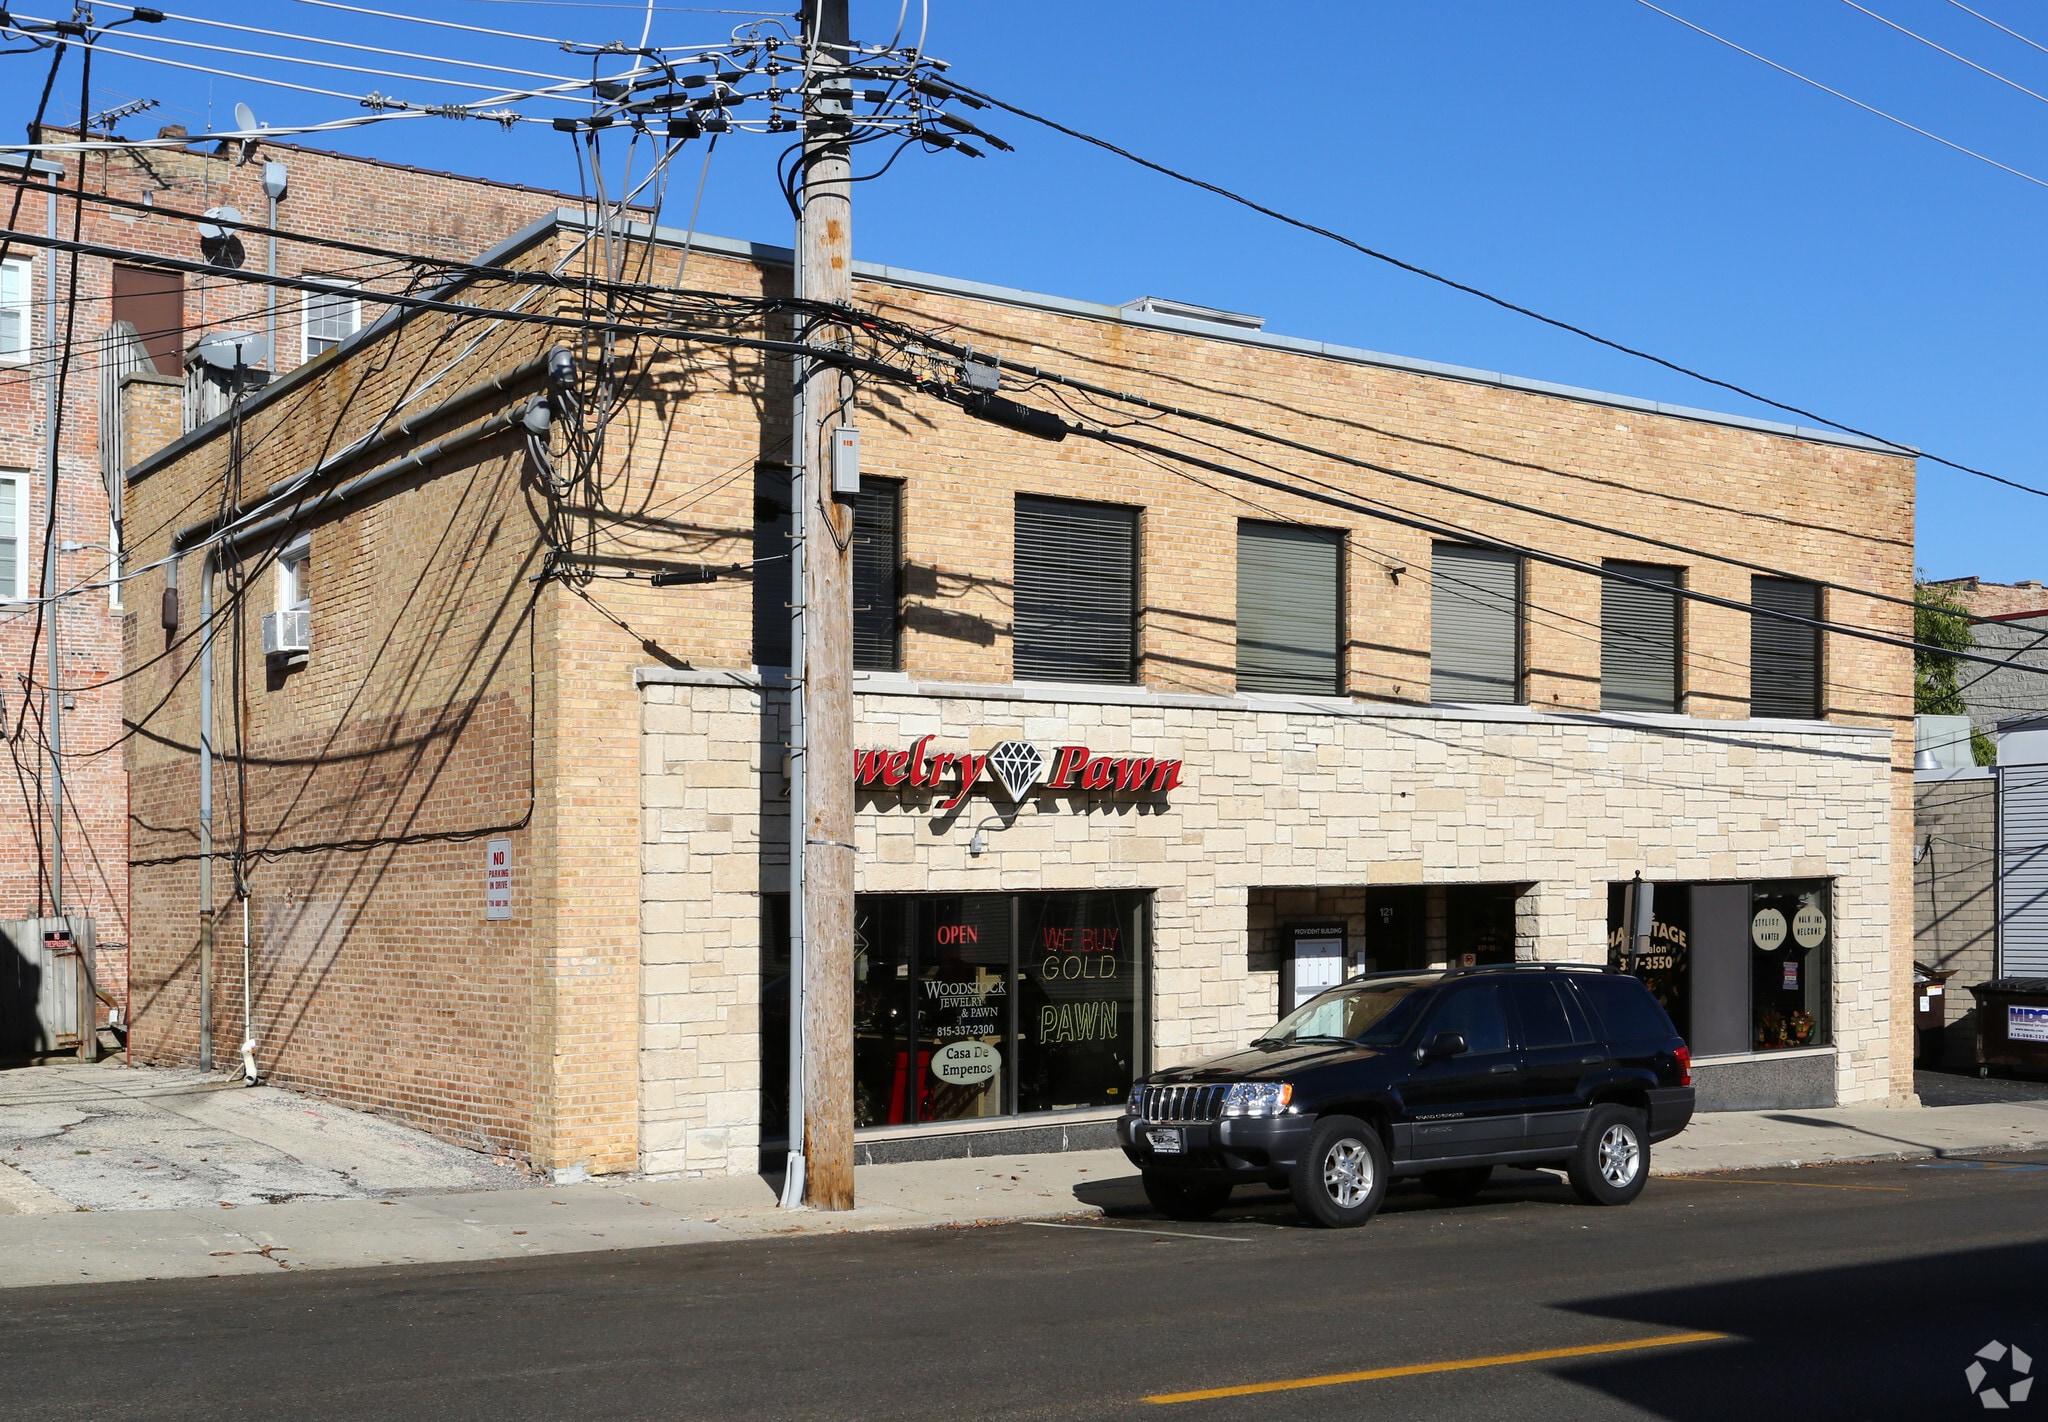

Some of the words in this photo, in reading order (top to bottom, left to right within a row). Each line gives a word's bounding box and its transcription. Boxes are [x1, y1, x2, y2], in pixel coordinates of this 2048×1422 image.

[854, 734, 986, 810] welry
[1048, 745, 1184, 793] Pawn
[493, 851, 504, 866] NO
[488, 869, 509, 878] PARKING
[489, 881, 494, 890] IN
[495, 880, 508, 889] DRIVE
[1379, 907, 1393, 917] 121
[1755, 918, 1779, 927] STYLIST
[1798, 915, 1811, 923] WALK
[1814, 915, 1822, 924] INS
[54, 932, 60, 940] NO
[937, 924, 979, 945] OPEN
[1320, 927, 1342, 935] BUILDING
[1761, 933, 1779, 941] WANTED
[1797, 927, 1821, 936] WELCOME
[1043, 927, 1074, 952] WE
[1081, 927, 1119, 952] BUY
[1649, 944, 1667, 955] alon
[1042, 955, 1116, 980] GOLD
[1619, 955, 1673, 972] 37-3550
[925, 981, 1006, 999] WOODSTOCK
[939, 997, 984, 1011] JEWELRY
[960, 1008, 969, 1018] &
[971, 1007, 999, 1018] PAWN
[2010, 1008, 2048, 1024] MDC
[1040, 1000, 1118, 1044] PAWN
[937, 1024, 995, 1037] 815-337-2300
[946, 1047, 971, 1060] Casa
[974, 1046, 989, 1058] De
[942, 1064, 993, 1079] Empenos
